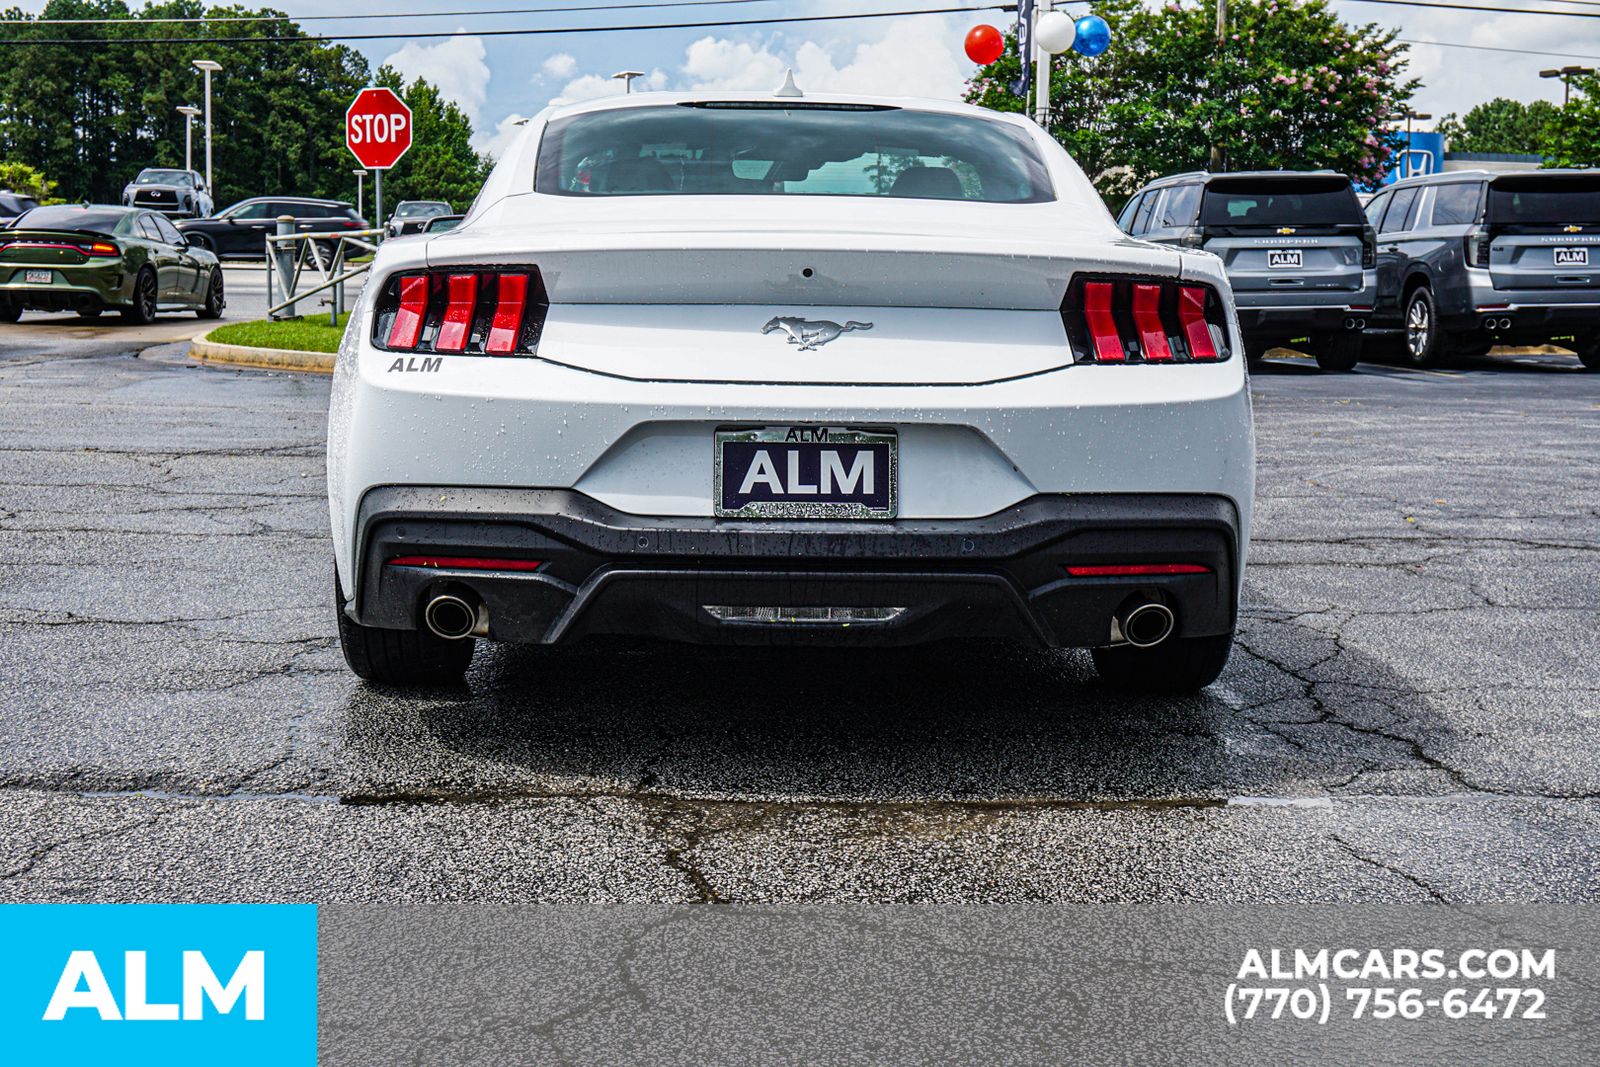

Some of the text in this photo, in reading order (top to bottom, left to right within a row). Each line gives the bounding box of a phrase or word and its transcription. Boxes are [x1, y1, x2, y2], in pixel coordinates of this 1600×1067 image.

[350, 113, 407, 144] STOP
[1271, 254, 1299, 264] ALM
[1558, 251, 1584, 261] ALM
[387, 357, 443, 373] ALM
[785, 427, 829, 442] ALM
[738, 450, 875, 495] ALM
